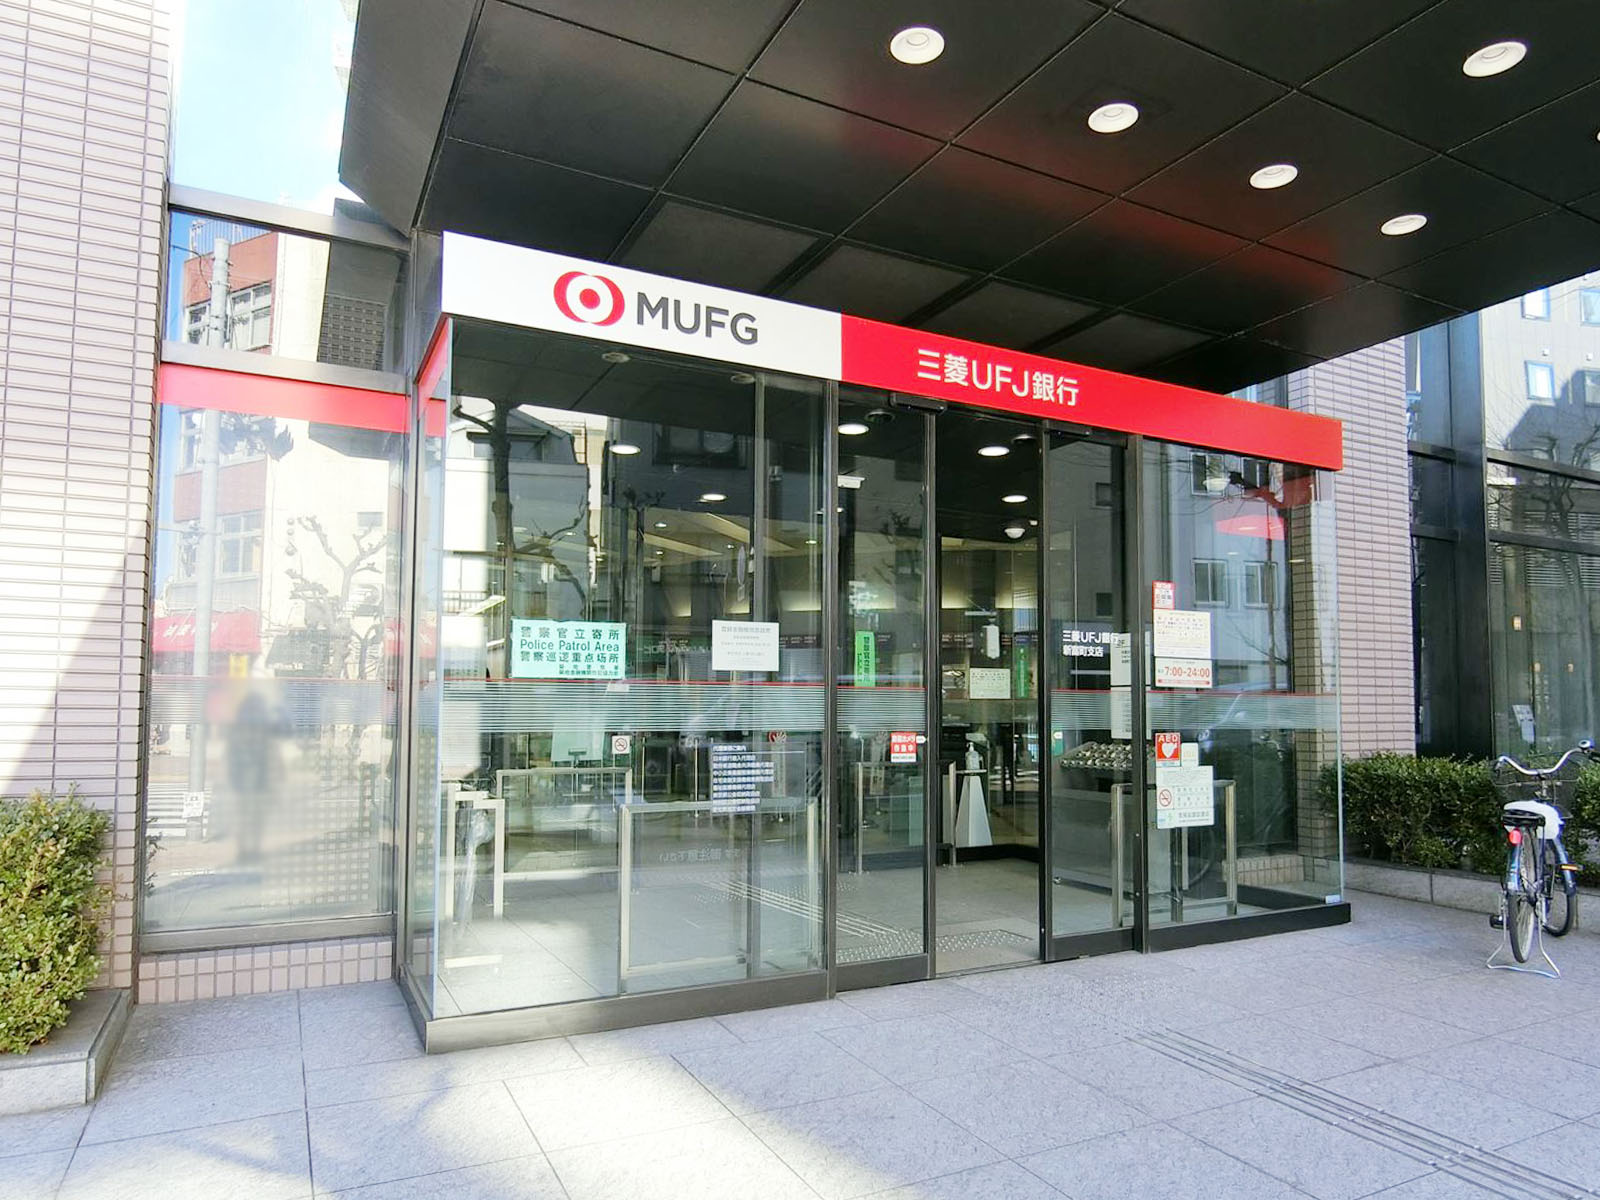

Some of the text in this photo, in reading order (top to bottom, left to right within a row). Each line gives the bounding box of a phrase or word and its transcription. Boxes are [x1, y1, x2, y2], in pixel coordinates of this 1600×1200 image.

[637, 292, 758, 345] MUFG
[917, 348, 1079, 406] 三菱UFJ銀行
[520, 639, 619, 652] Police Patrol Area
[1158, 734, 1178, 743] AED
